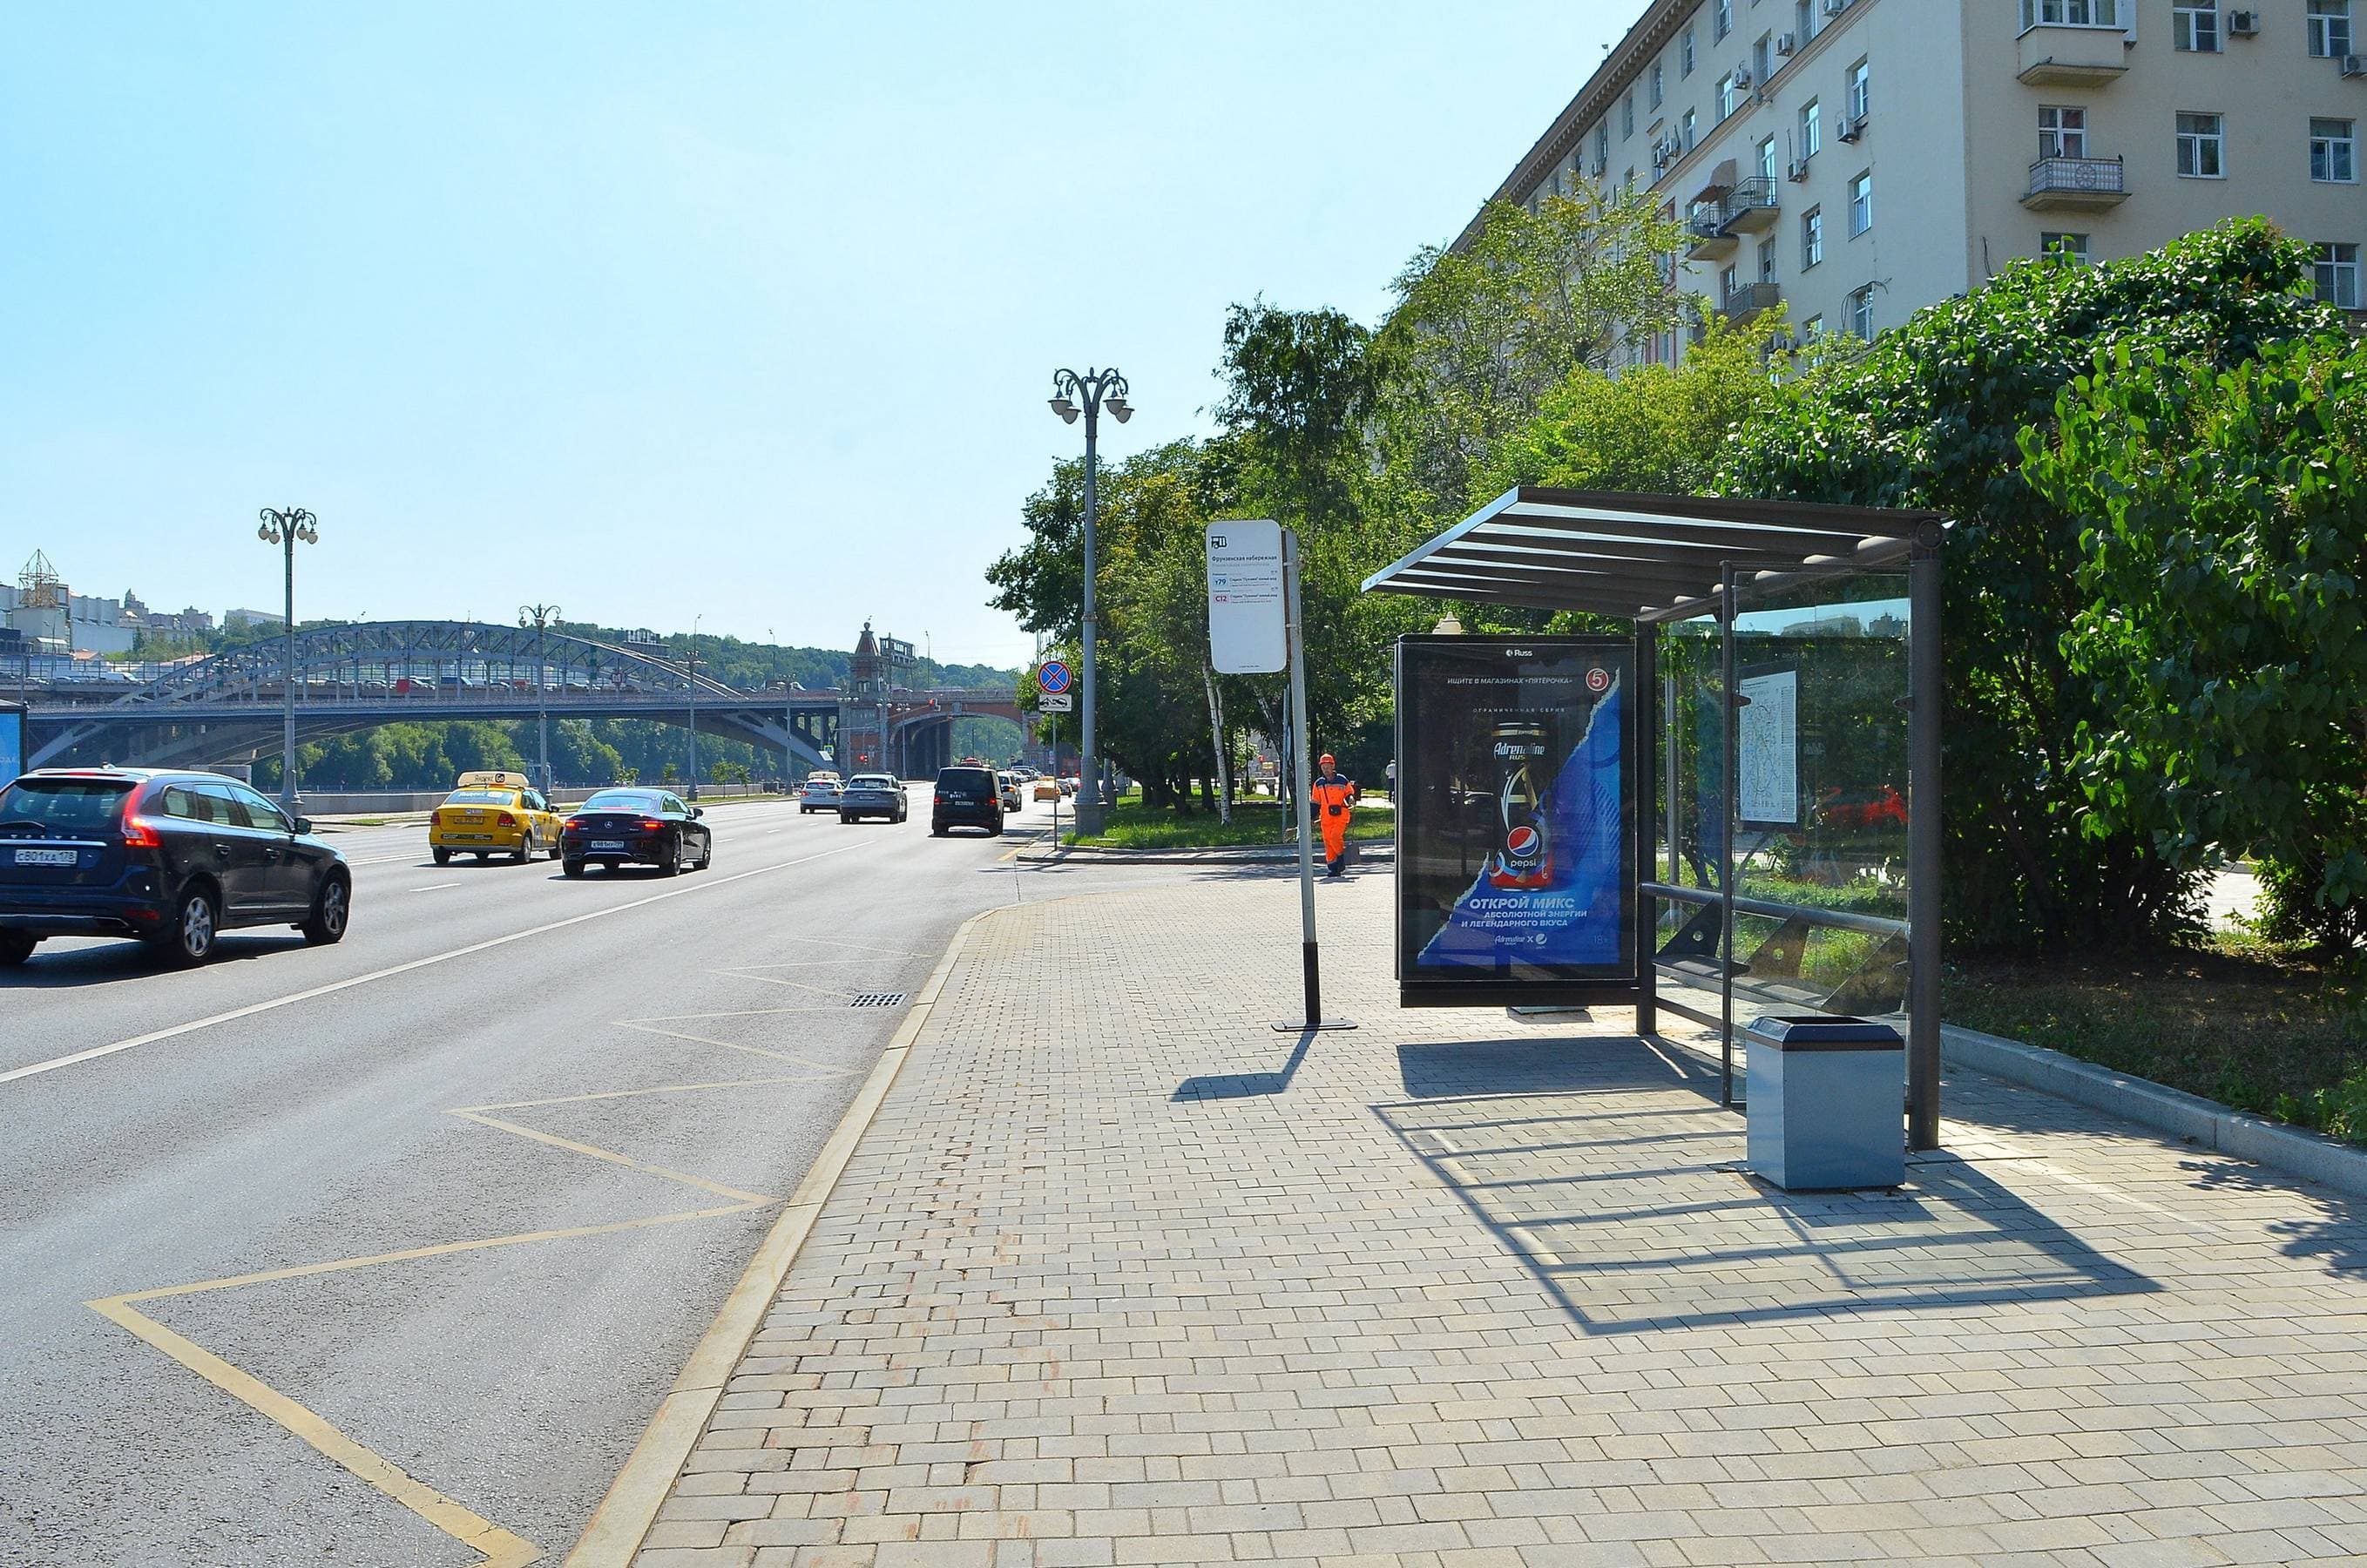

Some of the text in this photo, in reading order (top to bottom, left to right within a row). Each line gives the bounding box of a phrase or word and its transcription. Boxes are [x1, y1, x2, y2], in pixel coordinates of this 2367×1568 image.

[1511, 859, 1537, 868] pepsi
[1470, 896, 1576, 909] ОТКРОЙ МИКС
[1484, 910, 1546, 919] АБСОЛЮТНОЙ
